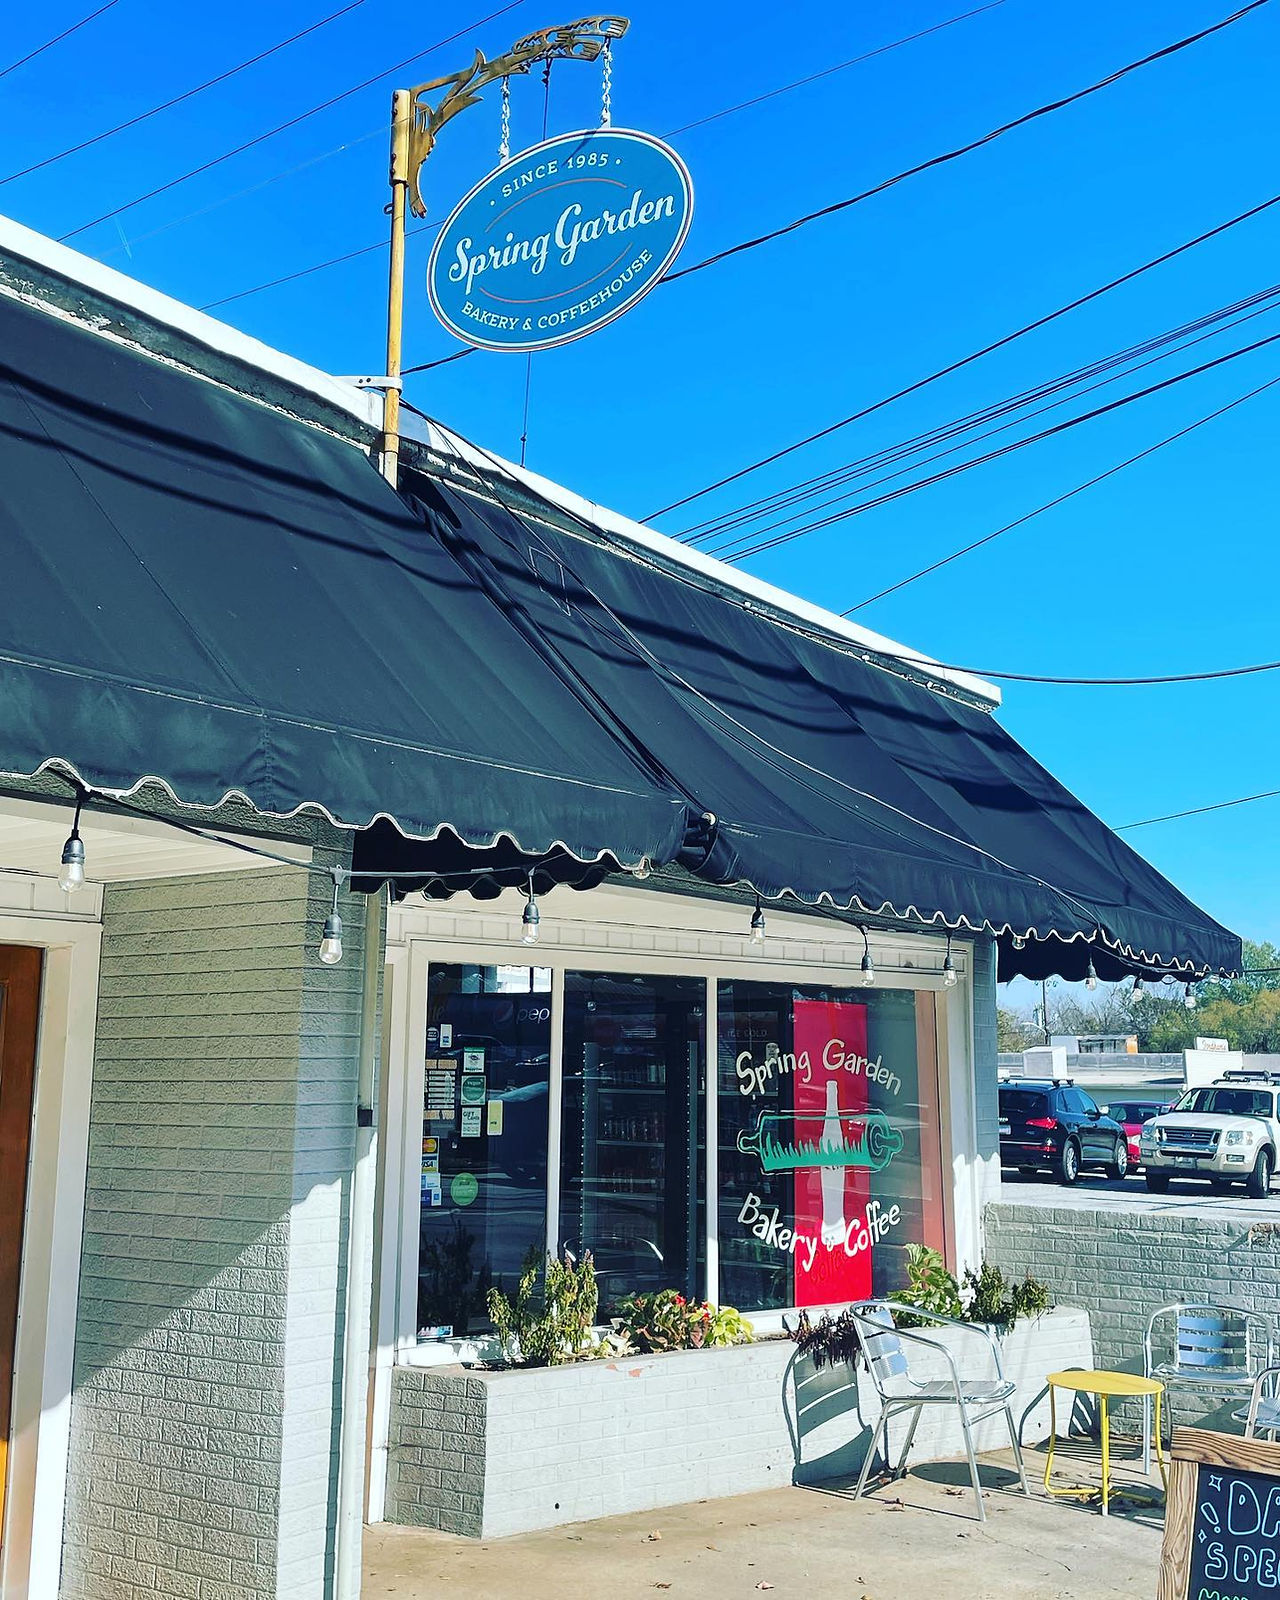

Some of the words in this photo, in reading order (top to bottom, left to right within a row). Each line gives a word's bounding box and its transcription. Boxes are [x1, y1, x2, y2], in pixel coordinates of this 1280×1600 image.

[501, 160, 558, 197] SINCE
[566, 152, 609, 169] 1985
[448, 232, 551, 295] Spring
[554, 189, 676, 266] Garden
[461, 301, 520, 330] BAKERY
[522, 318, 532, 331] &
[537, 249, 653, 329] COFFEEHOUSE
[736, 1050, 810, 1095] Spring
[822, 1038, 902, 1096] Garden
[737, 1192, 818, 1272] Bakery
[844, 1200, 902, 1258] Coffee
[1204, 1542, 1280, 1588] SPE
